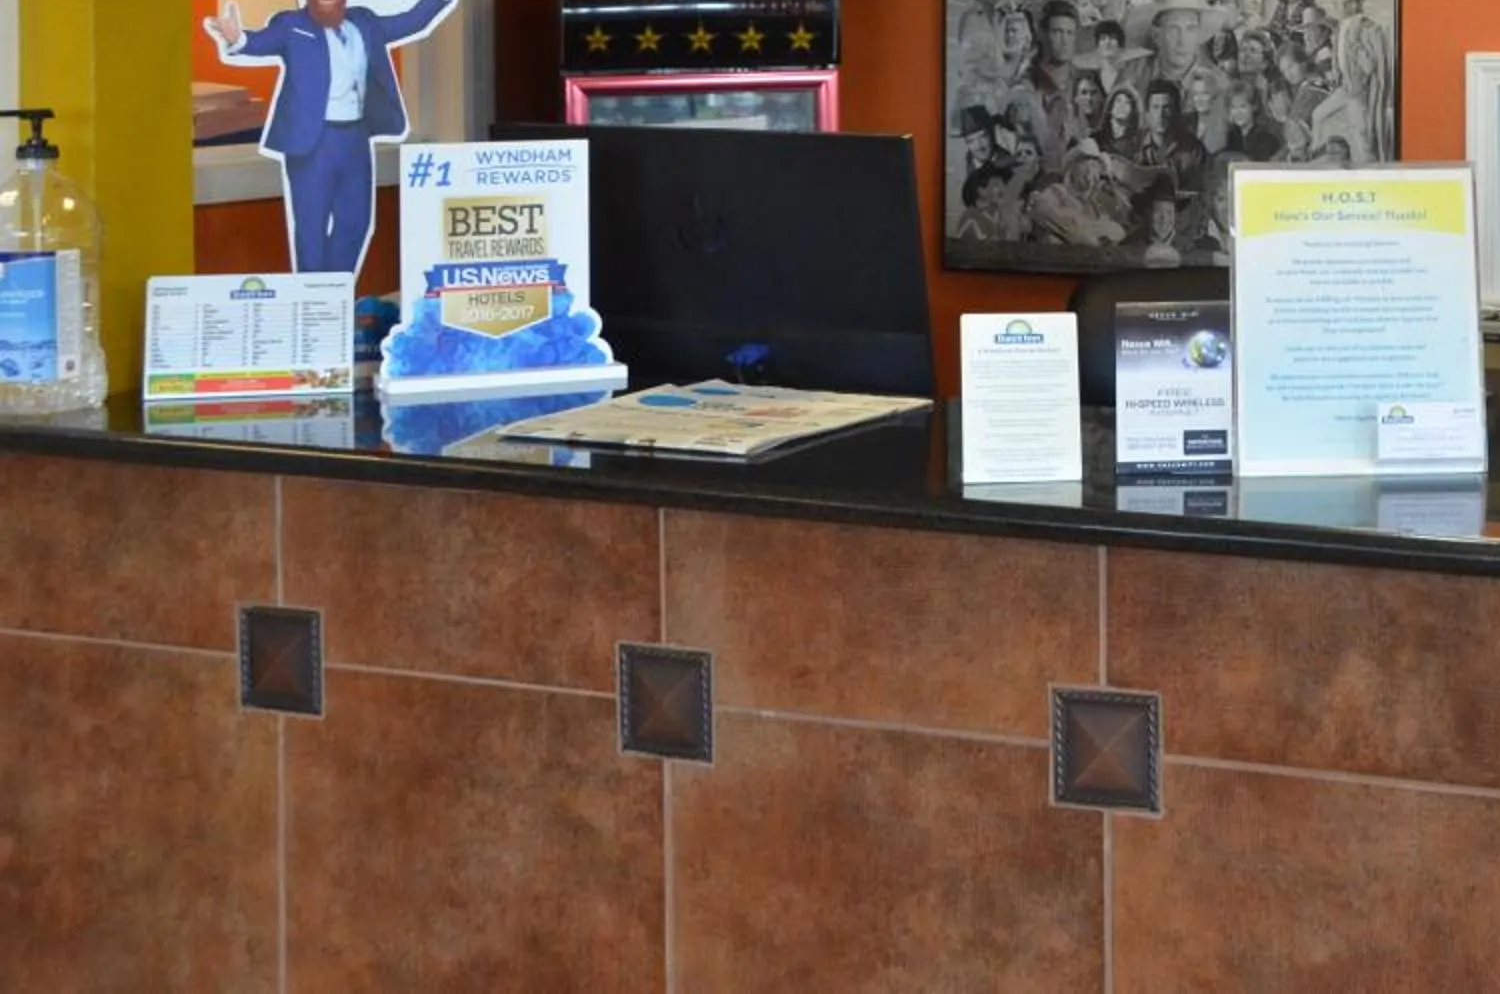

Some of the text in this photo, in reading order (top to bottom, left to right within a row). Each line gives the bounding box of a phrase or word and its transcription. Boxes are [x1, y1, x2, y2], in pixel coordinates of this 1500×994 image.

[408, 148, 573, 187] #1 WYNDHAM
[477, 169, 572, 185] REWARDS
[447, 204, 544, 237] BEST
[448, 238, 545, 259] TRAVEL REWARDS
[468, 290, 525, 304] HOTELS
